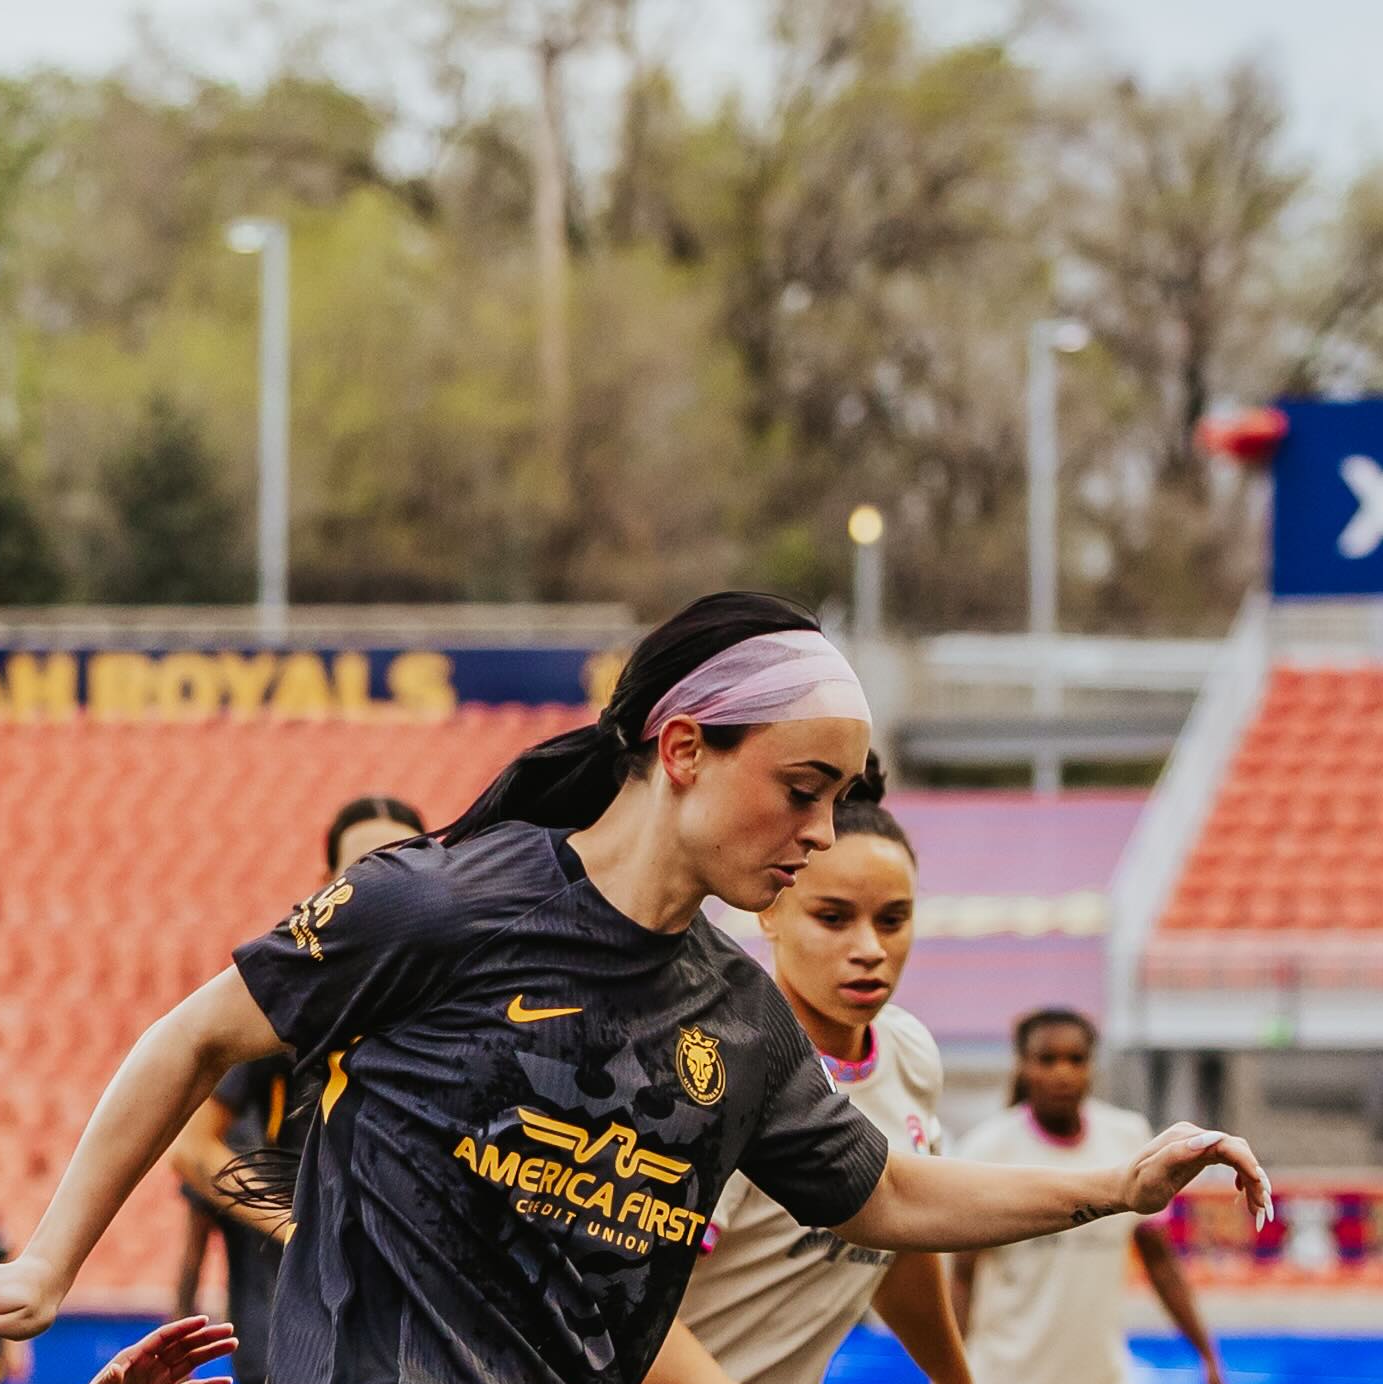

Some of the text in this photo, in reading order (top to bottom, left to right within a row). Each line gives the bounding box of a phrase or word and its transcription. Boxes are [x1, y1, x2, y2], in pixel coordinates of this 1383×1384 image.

[84, 648, 460, 725] ROYALS
[453, 1135, 706, 1247] AMERICA FIRST
[586, 1221, 649, 1255] UNION
